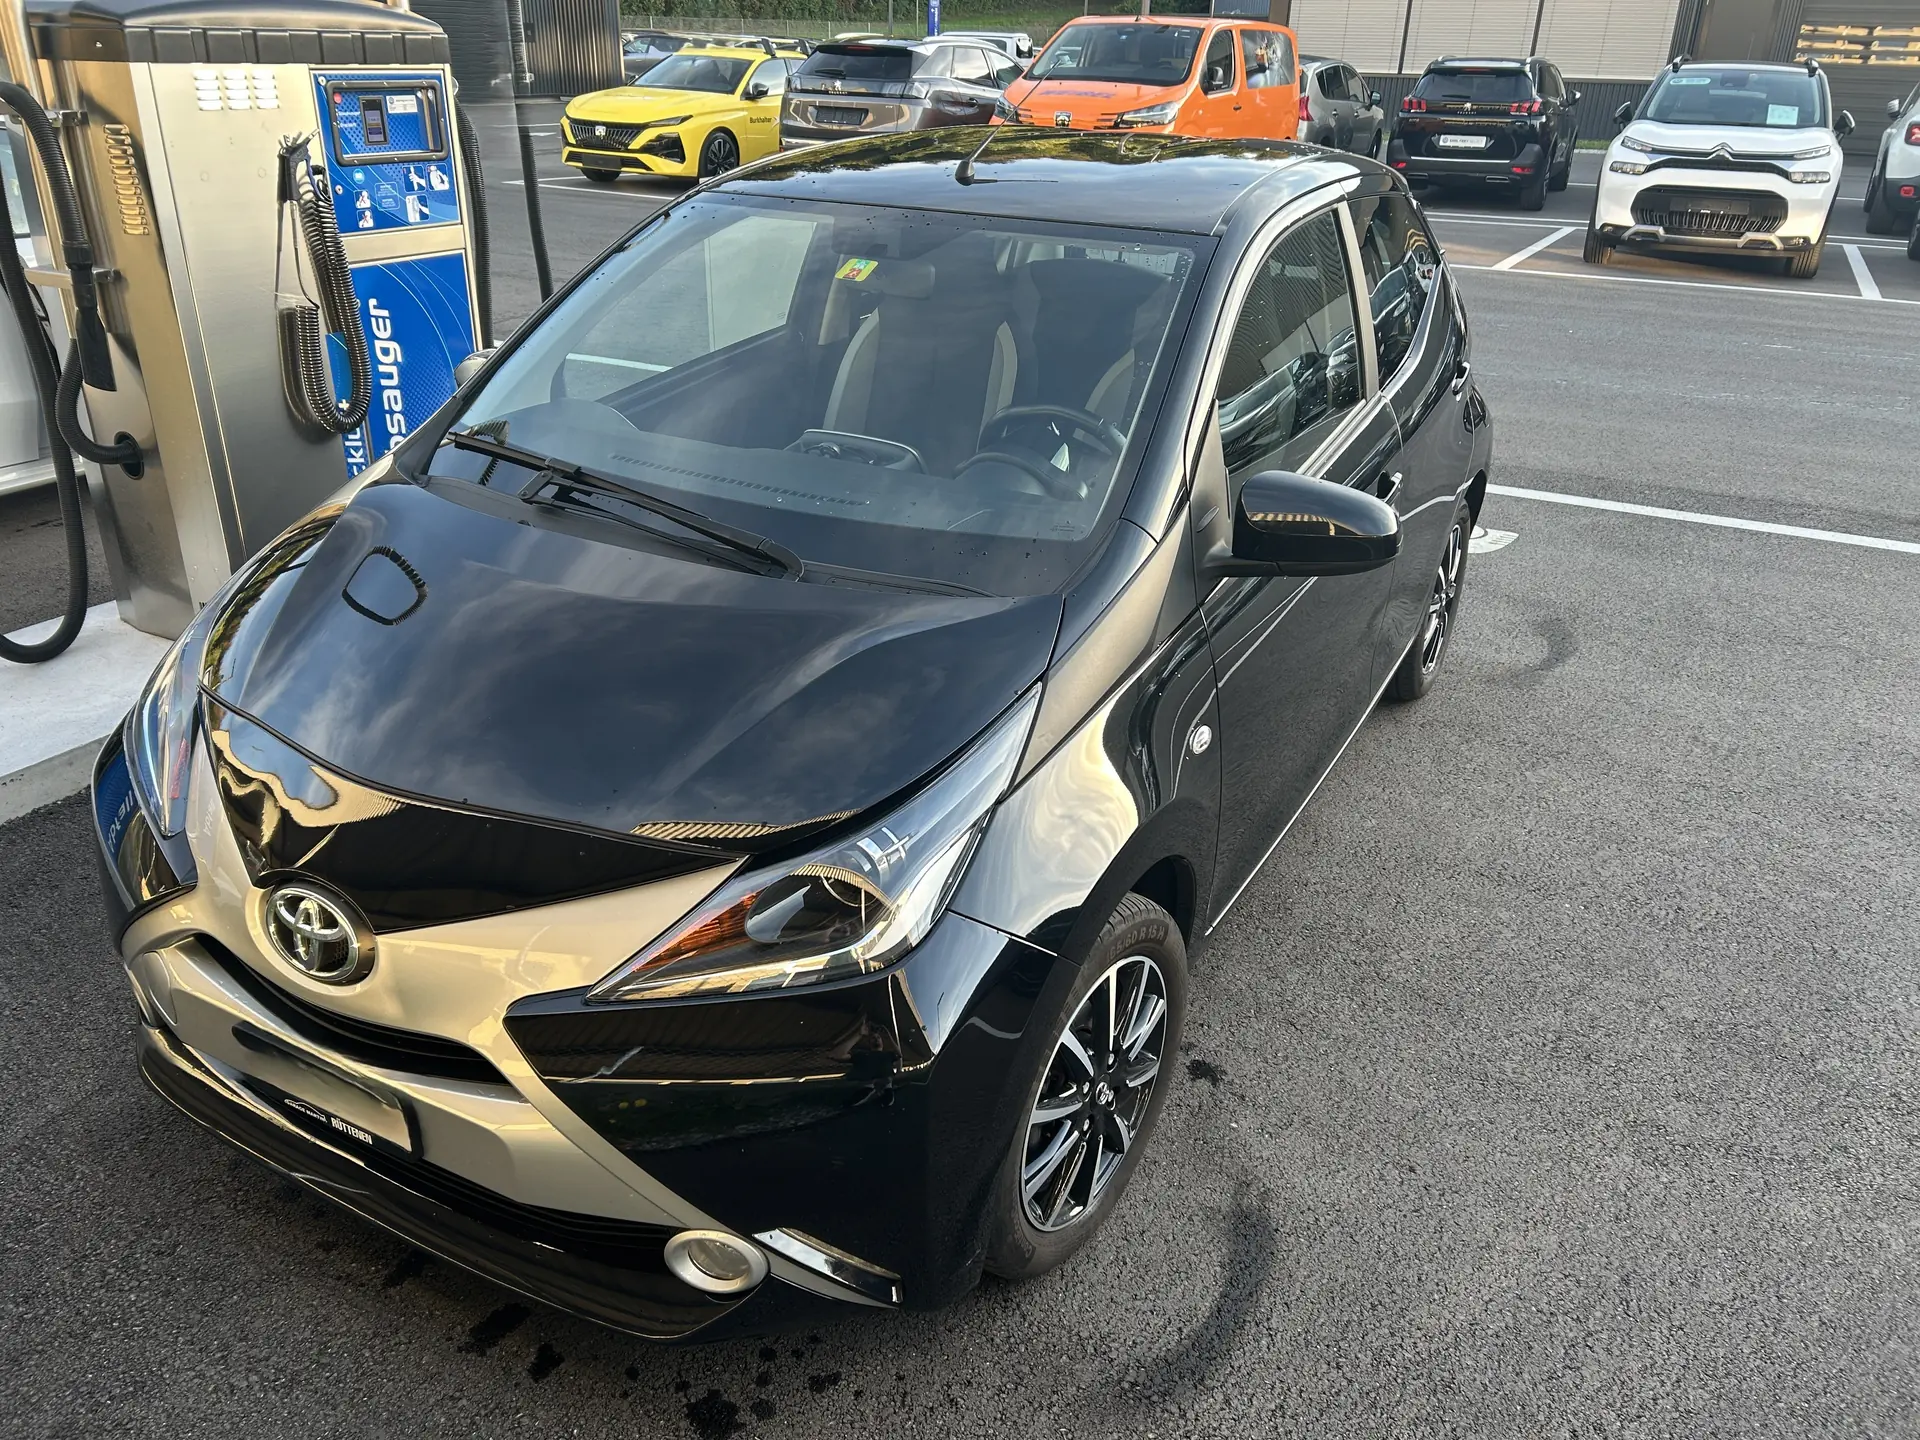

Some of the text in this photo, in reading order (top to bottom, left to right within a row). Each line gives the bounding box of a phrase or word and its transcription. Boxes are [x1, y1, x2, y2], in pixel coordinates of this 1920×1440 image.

[749, 116, 773, 124] Burkhalter
[1139, 927, 1147, 941] R
[330, 1117, 373, 1145] RÜTTENEN
